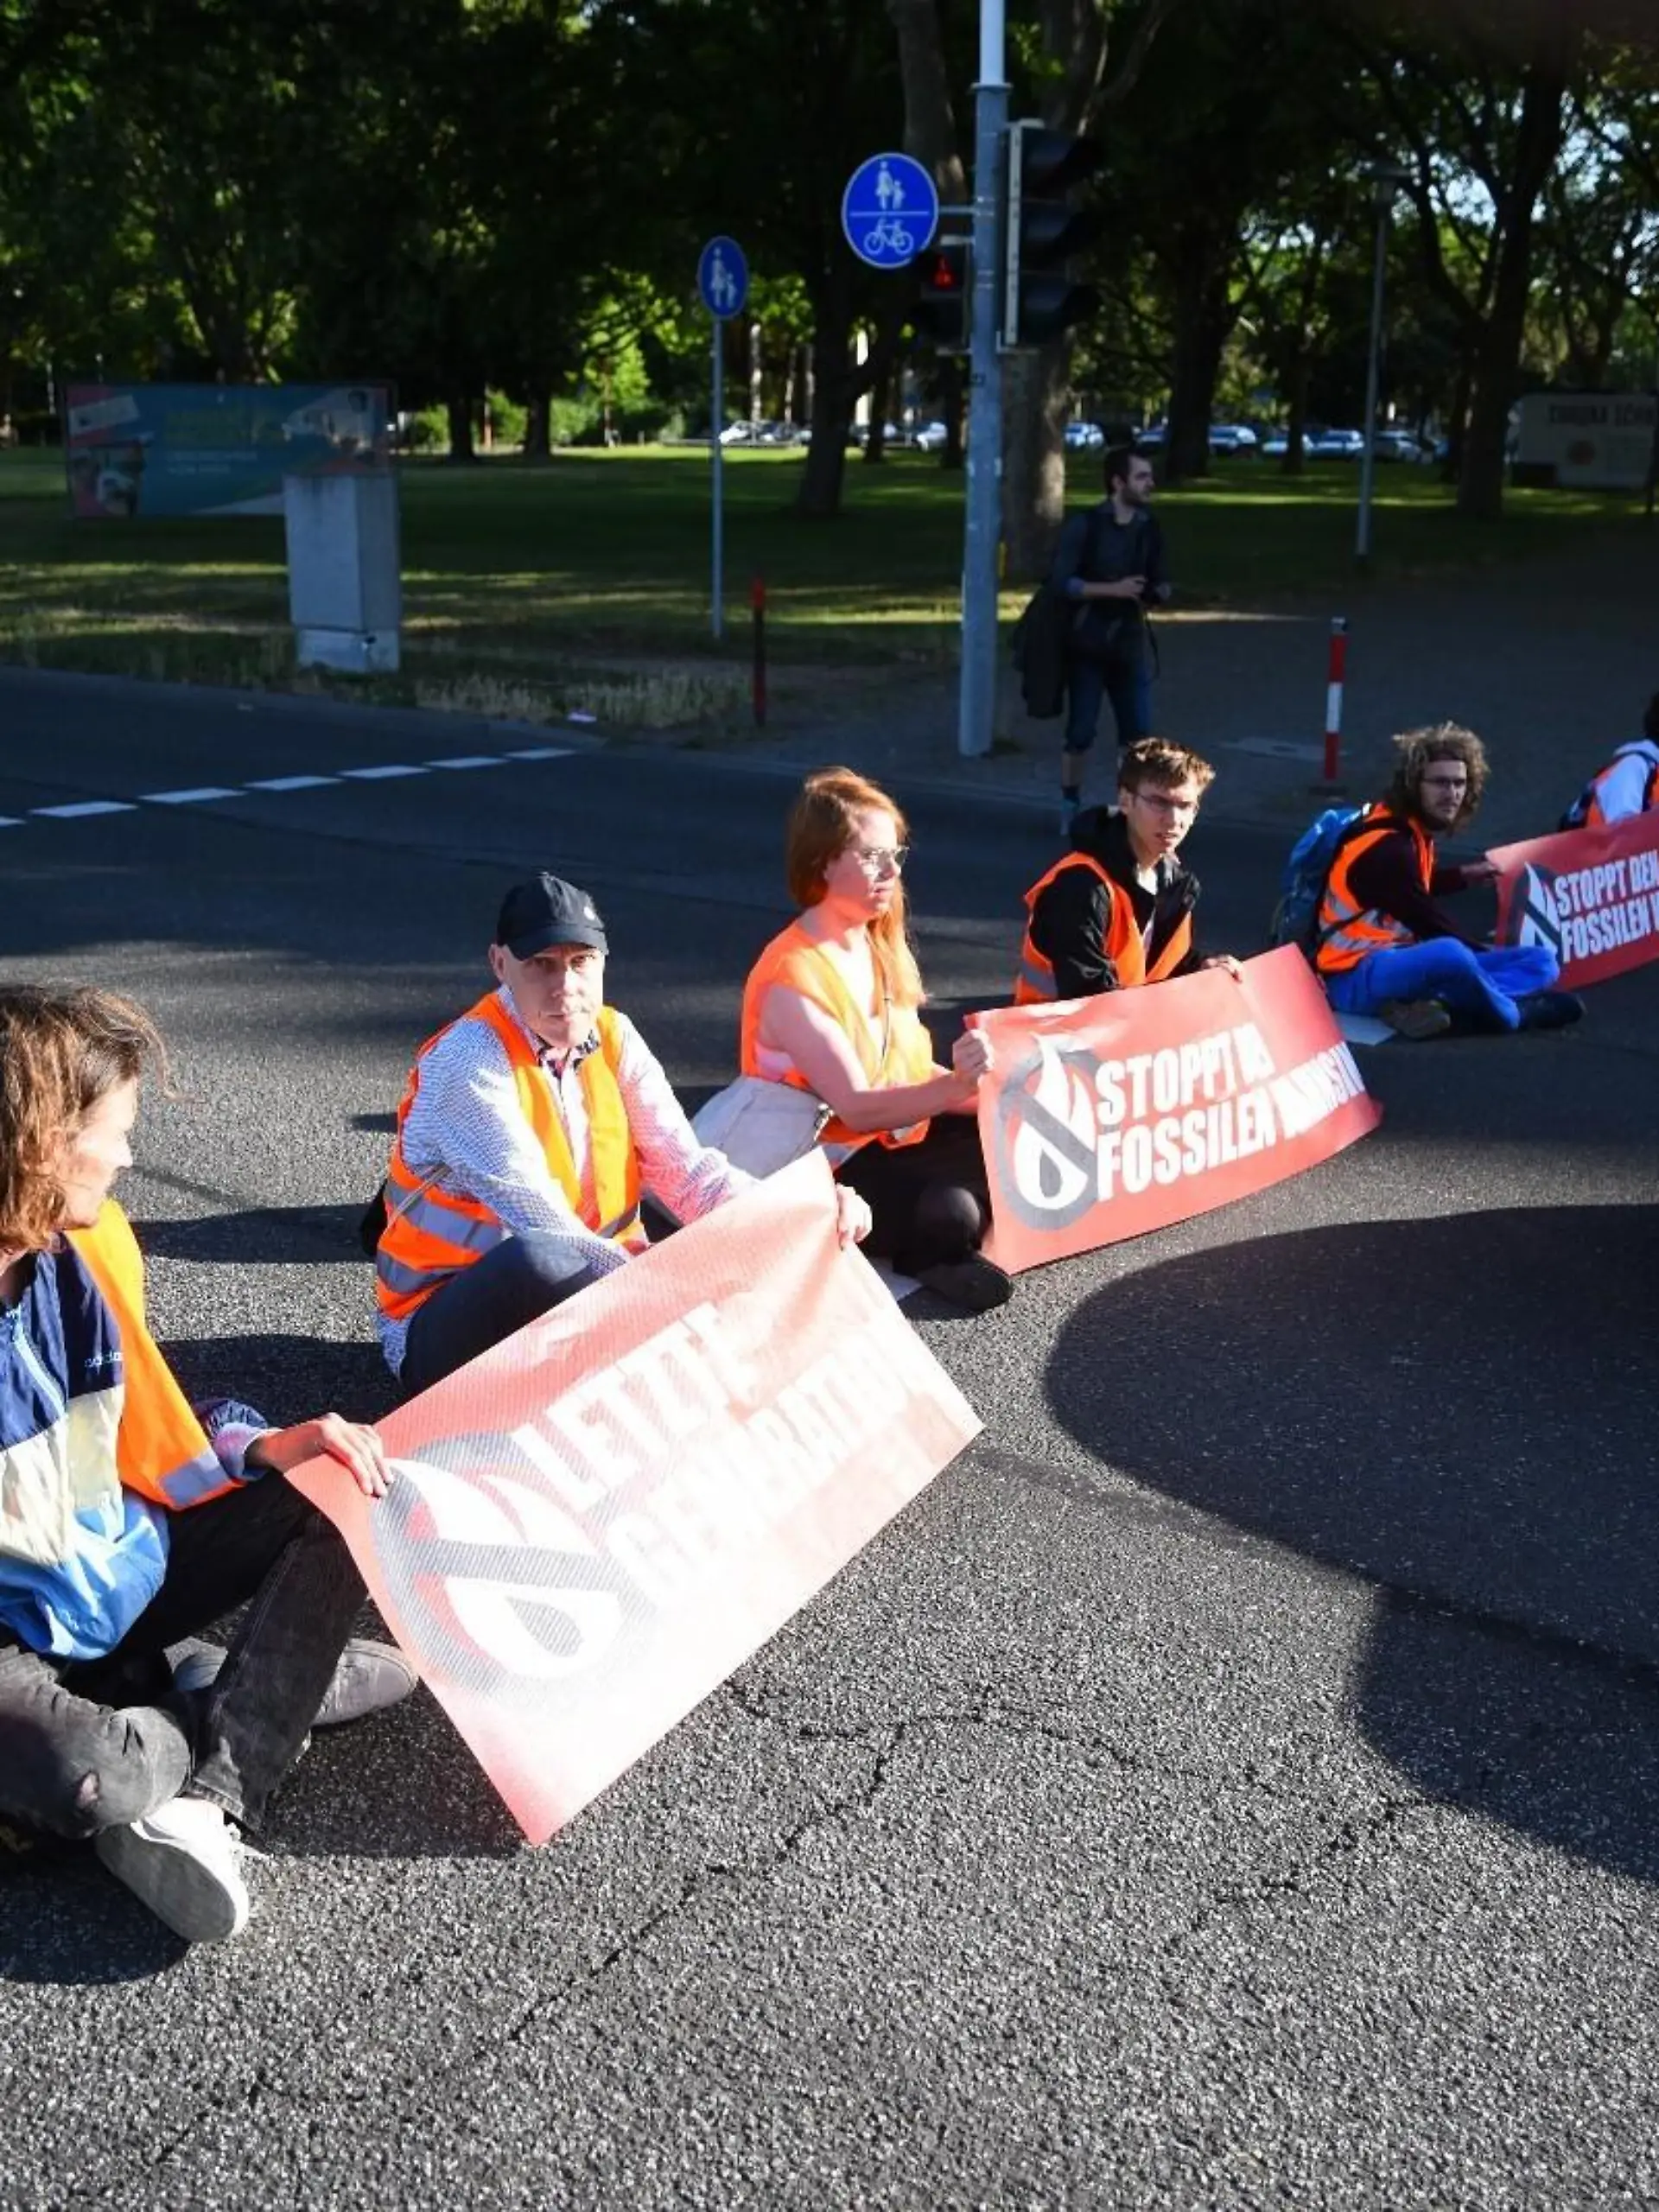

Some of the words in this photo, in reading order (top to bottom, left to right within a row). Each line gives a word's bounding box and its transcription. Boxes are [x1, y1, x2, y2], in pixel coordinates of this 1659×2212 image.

[1554, 860, 1627, 918] STOPPT
[1560, 893, 1652, 963] FOSSILEN
[1095, 1030, 1237, 1126] STOPPT
[1096, 1086, 1277, 1203] FOSSILEN
[512, 1300, 764, 1512] LETZTE
